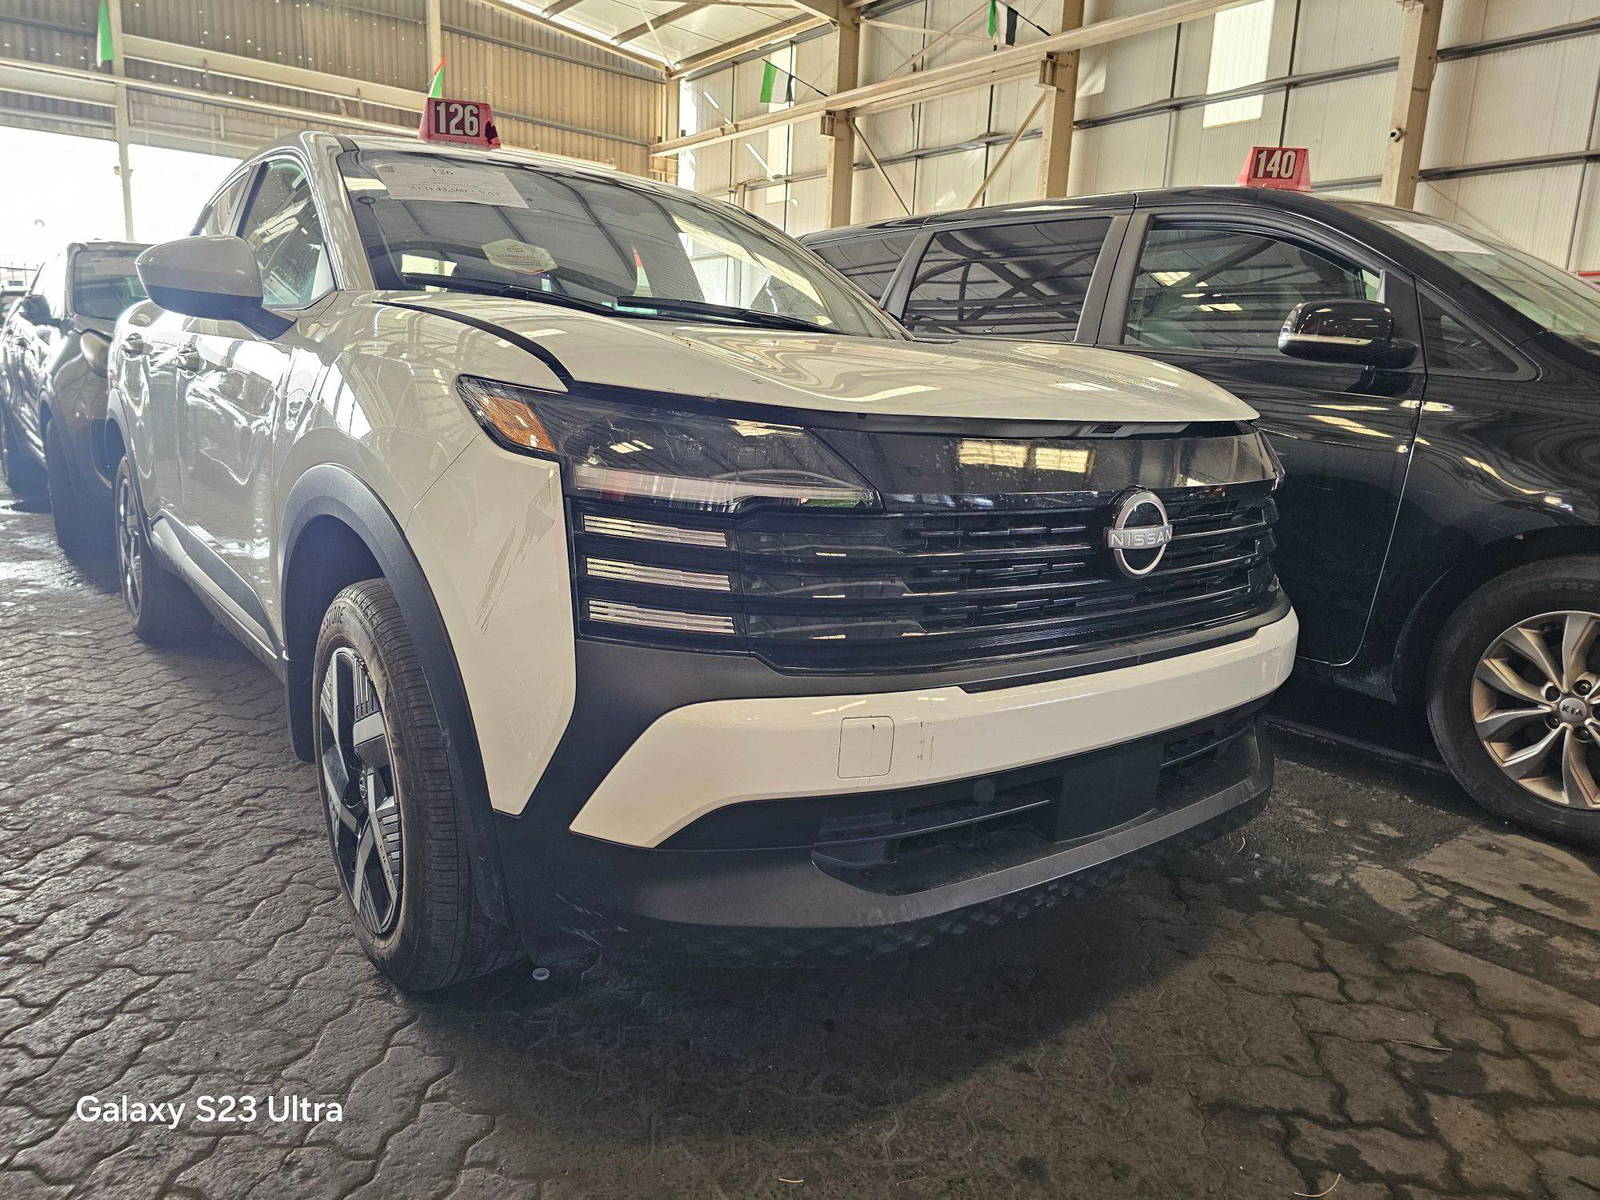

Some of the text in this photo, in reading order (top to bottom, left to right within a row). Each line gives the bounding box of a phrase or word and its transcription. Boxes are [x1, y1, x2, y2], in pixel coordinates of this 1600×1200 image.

[436, 102, 479, 136] 126
[1257, 150, 1296, 178] 140
[1111, 527, 1172, 546] NISSAN
[1562, 704, 1583, 716] KIA
